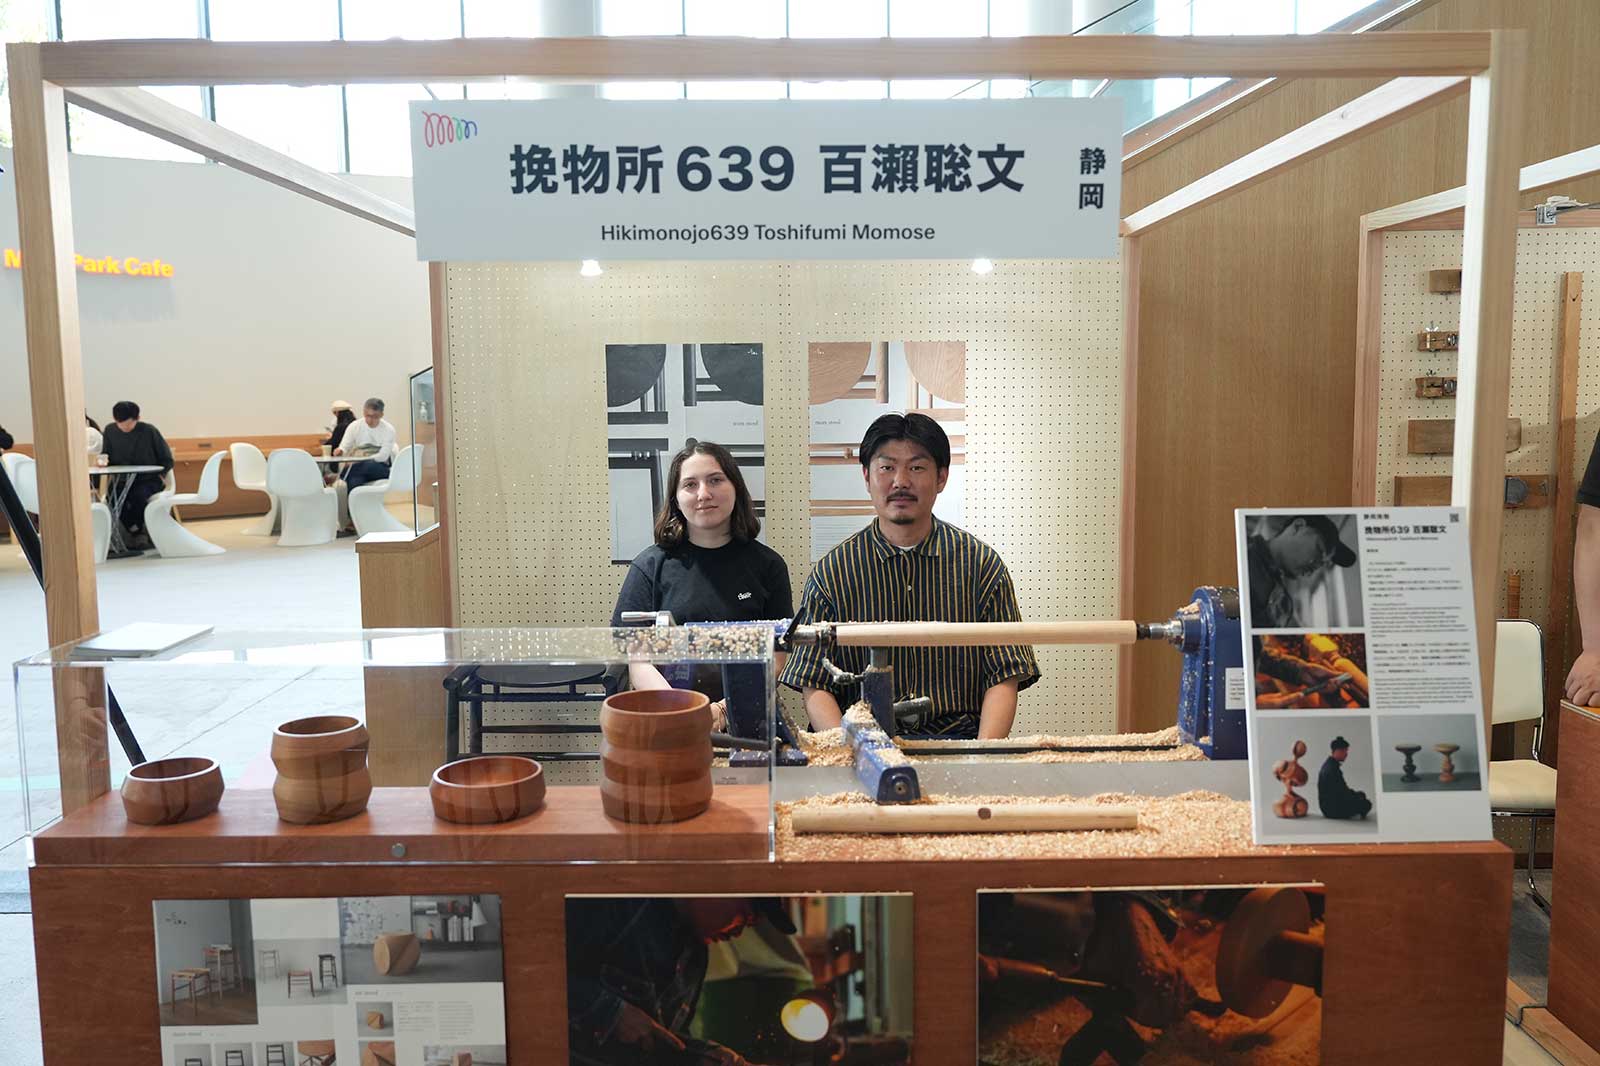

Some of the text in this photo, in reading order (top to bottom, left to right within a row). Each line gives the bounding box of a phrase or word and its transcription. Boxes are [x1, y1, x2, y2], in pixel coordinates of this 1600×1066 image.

[1078, 147, 1107, 210] 静岡
[601, 223, 936, 245] Hikimonojo639 Toshifumi Momose
[124, 256, 175, 278] Cafe
